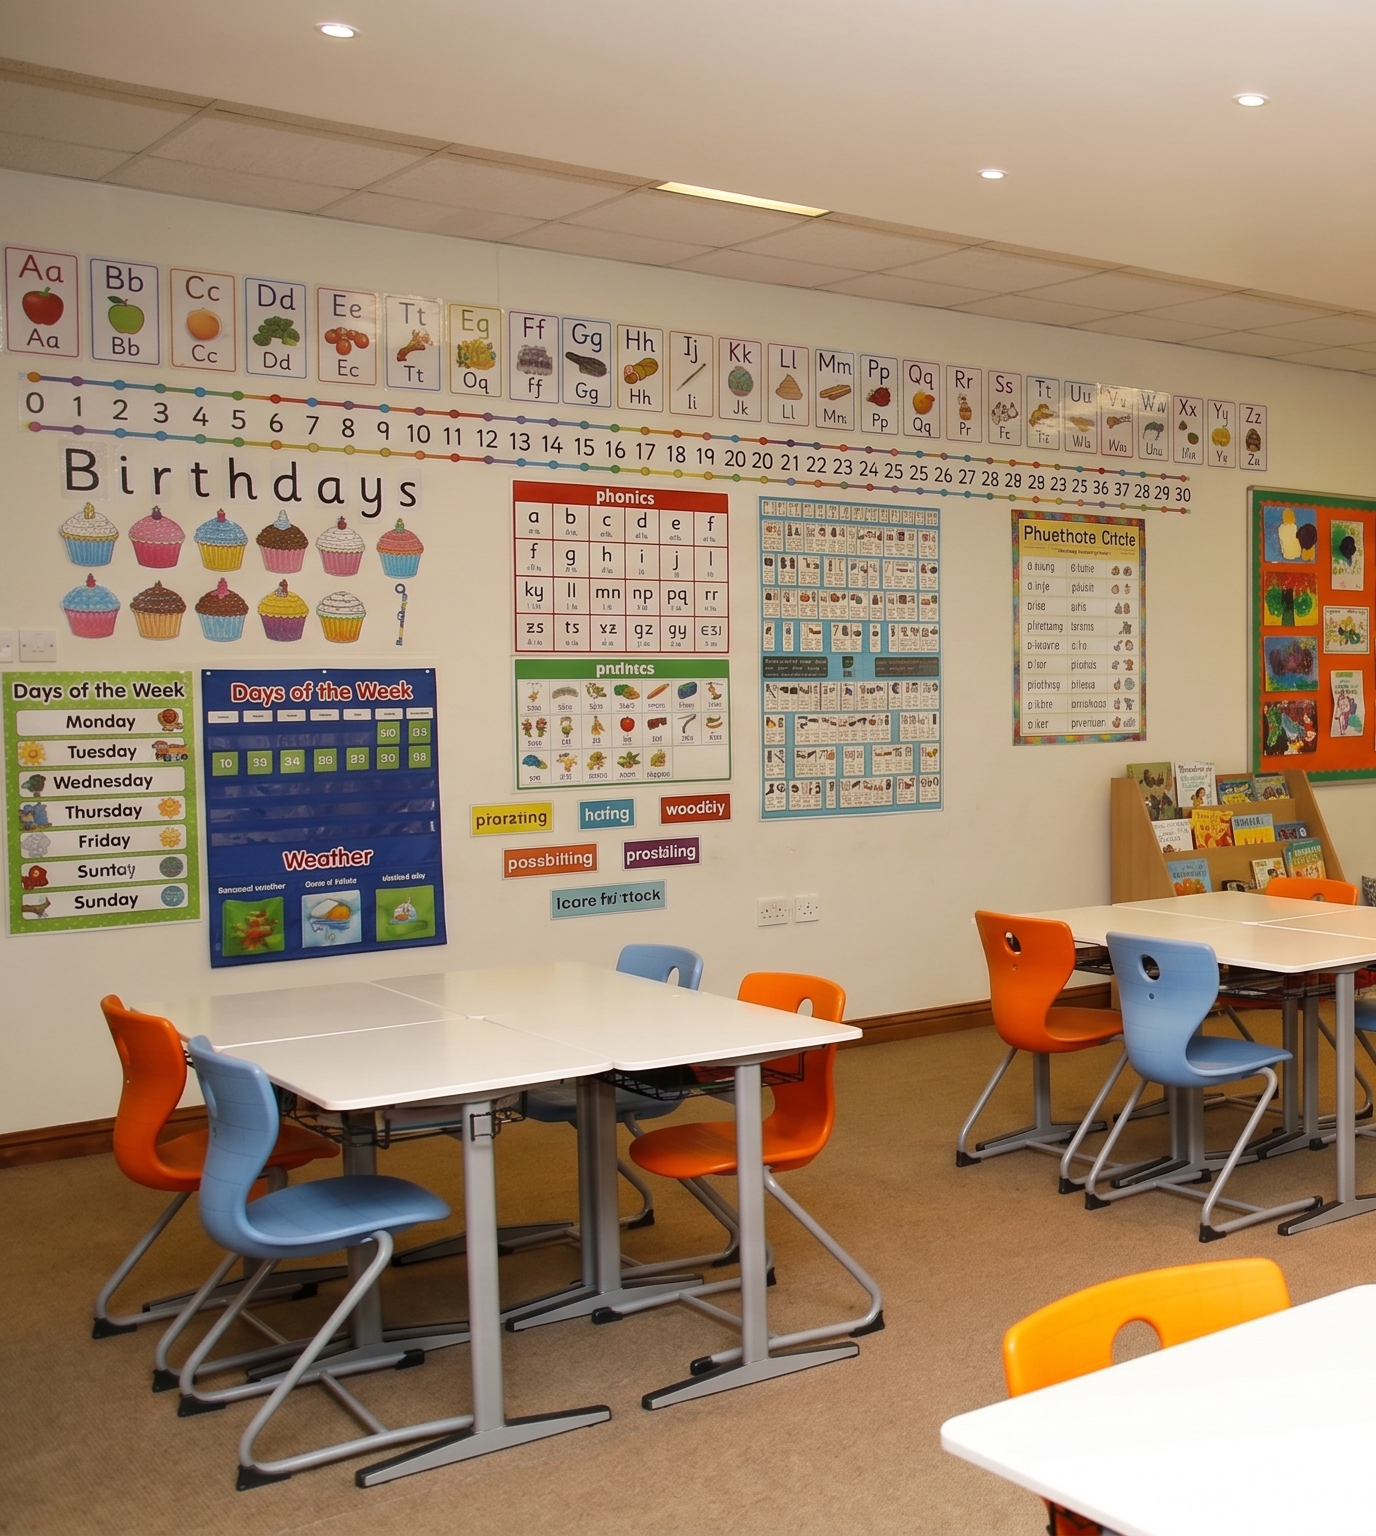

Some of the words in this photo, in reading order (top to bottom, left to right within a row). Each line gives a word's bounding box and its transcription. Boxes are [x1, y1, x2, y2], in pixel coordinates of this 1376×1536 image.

[18, 253, 65, 284] Aa
[106, 262, 147, 292] Bb
[186, 275, 220, 302] Cc
[258, 283, 296, 310] Dd
[333, 294, 362, 318] Ee
[398, 302, 426, 326] Tt
[462, 309, 489, 340] Eg
[524, 317, 546, 340] Ff
[26, 328, 61, 351] Aa
[112, 336, 140, 356] Bb
[572, 323, 602, 353] Gg
[626, 329, 655, 352] Hh
[192, 344, 217, 363] Cc
[264, 351, 291, 370] Dd
[684, 336, 698, 364] Ij
[730, 341, 754, 364] Kk
[780, 348, 797, 370] Ll
[403, 365, 424, 383] Tt
[819, 351, 852, 375] Mm
[868, 359, 890, 385] Pp
[909, 364, 934, 390] Qq
[956, 370, 973, 389] Rr
[996, 375, 1013, 394] Ss
[576, 382, 598, 406] Gg
[630, 388, 652, 405] Hh
[1035, 380, 1051, 399] Tt
[1070, 384, 1091, 403] Uu
[782, 404, 796, 420] Ll
[1179, 398, 1197, 417] Xx
[1213, 402, 1228, 428] Yy
[1246, 406, 1262, 424] Zz
[872, 413, 888, 432] Pp
[913, 417, 931, 436] Qq
[26, 392, 44, 414] 0
[73, 396, 81, 416] 1
[112, 399, 128, 420] 2
[153, 402, 169, 424] 3
[192, 406, 209, 426] 4
[231, 410, 246, 430] 5
[270, 413, 283, 433] 6
[306, 415, 320, 435] 7
[342, 418, 354, 438] 8
[377, 421, 389, 440] 9
[407, 424, 430, 444] 10
[444, 427, 461, 446] 11
[476, 429, 498, 448] 12
[510, 432, 530, 451] 13
[542, 435, 563, 454] 14
[574, 438, 594, 456] 15
[606, 440, 626, 459] 16
[636, 442, 656, 460] 17
[667, 445, 686, 463] 18
[696, 448, 714, 465] 19
[724, 450, 746, 468] 20
[752, 452, 773, 470] 20
[781, 454, 798, 471] 21
[806, 456, 826, 474] 22
[833, 458, 852, 475] 23
[859, 460, 879, 477] 24
[884, 462, 903, 479] 25
[910, 464, 928, 481] 25
[934, 466, 952, 483] 26
[958, 469, 976, 484] 27
[982, 470, 999, 487] 28
[1050, 476, 1066, 492] 23
[1072, 478, 1088, 494] 25
[1093, 480, 1109, 495] 36
[1114, 482, 1130, 497] 37
[1134, 484, 1150, 499] 28
[1154, 485, 1170, 500] 29
[1175, 487, 1191, 502] 30
[65, 448, 417, 518] Birthdays
[596, 488, 654, 505] phonics
[528, 512, 539, 523] a
[566, 507, 576, 524] b
[602, 516, 611, 527] c
[637, 512, 647, 528] d
[672, 519, 680, 530] e
[707, 516, 715, 532] f
[530, 542, 538, 559] f
[566, 550, 575, 566] g
[602, 546, 612, 562] h
[640, 549, 643, 563] i
[672, 550, 678, 571] j
[525, 581, 543, 602] ky
[596, 588, 620, 599] mn
[633, 589, 653, 604] np
[668, 590, 688, 606] pq
[705, 590, 718, 600] rr
[526, 623, 544, 634] zs
[565, 621, 579, 634] ts
[634, 624, 653, 639] gz
[668, 624, 686, 640] gy
[14, 684, 62, 703] Days
[69, 682, 89, 698] of
[94, 682, 126, 698] the
[132, 682, 184, 698] Week
[231, 681, 284, 706] Days
[290, 681, 313, 700] of
[317, 680, 353, 700] the
[356, 680, 413, 699] Week
[66, 714, 136, 732] Monday
[67, 744, 137, 761] Tuesday
[53, 773, 153, 790] Wednesday
[65, 803, 142, 820] Thursday
[79, 833, 130, 850] Friday
[282, 847, 373, 871] Weather
[74, 892, 138, 909] Sunday
